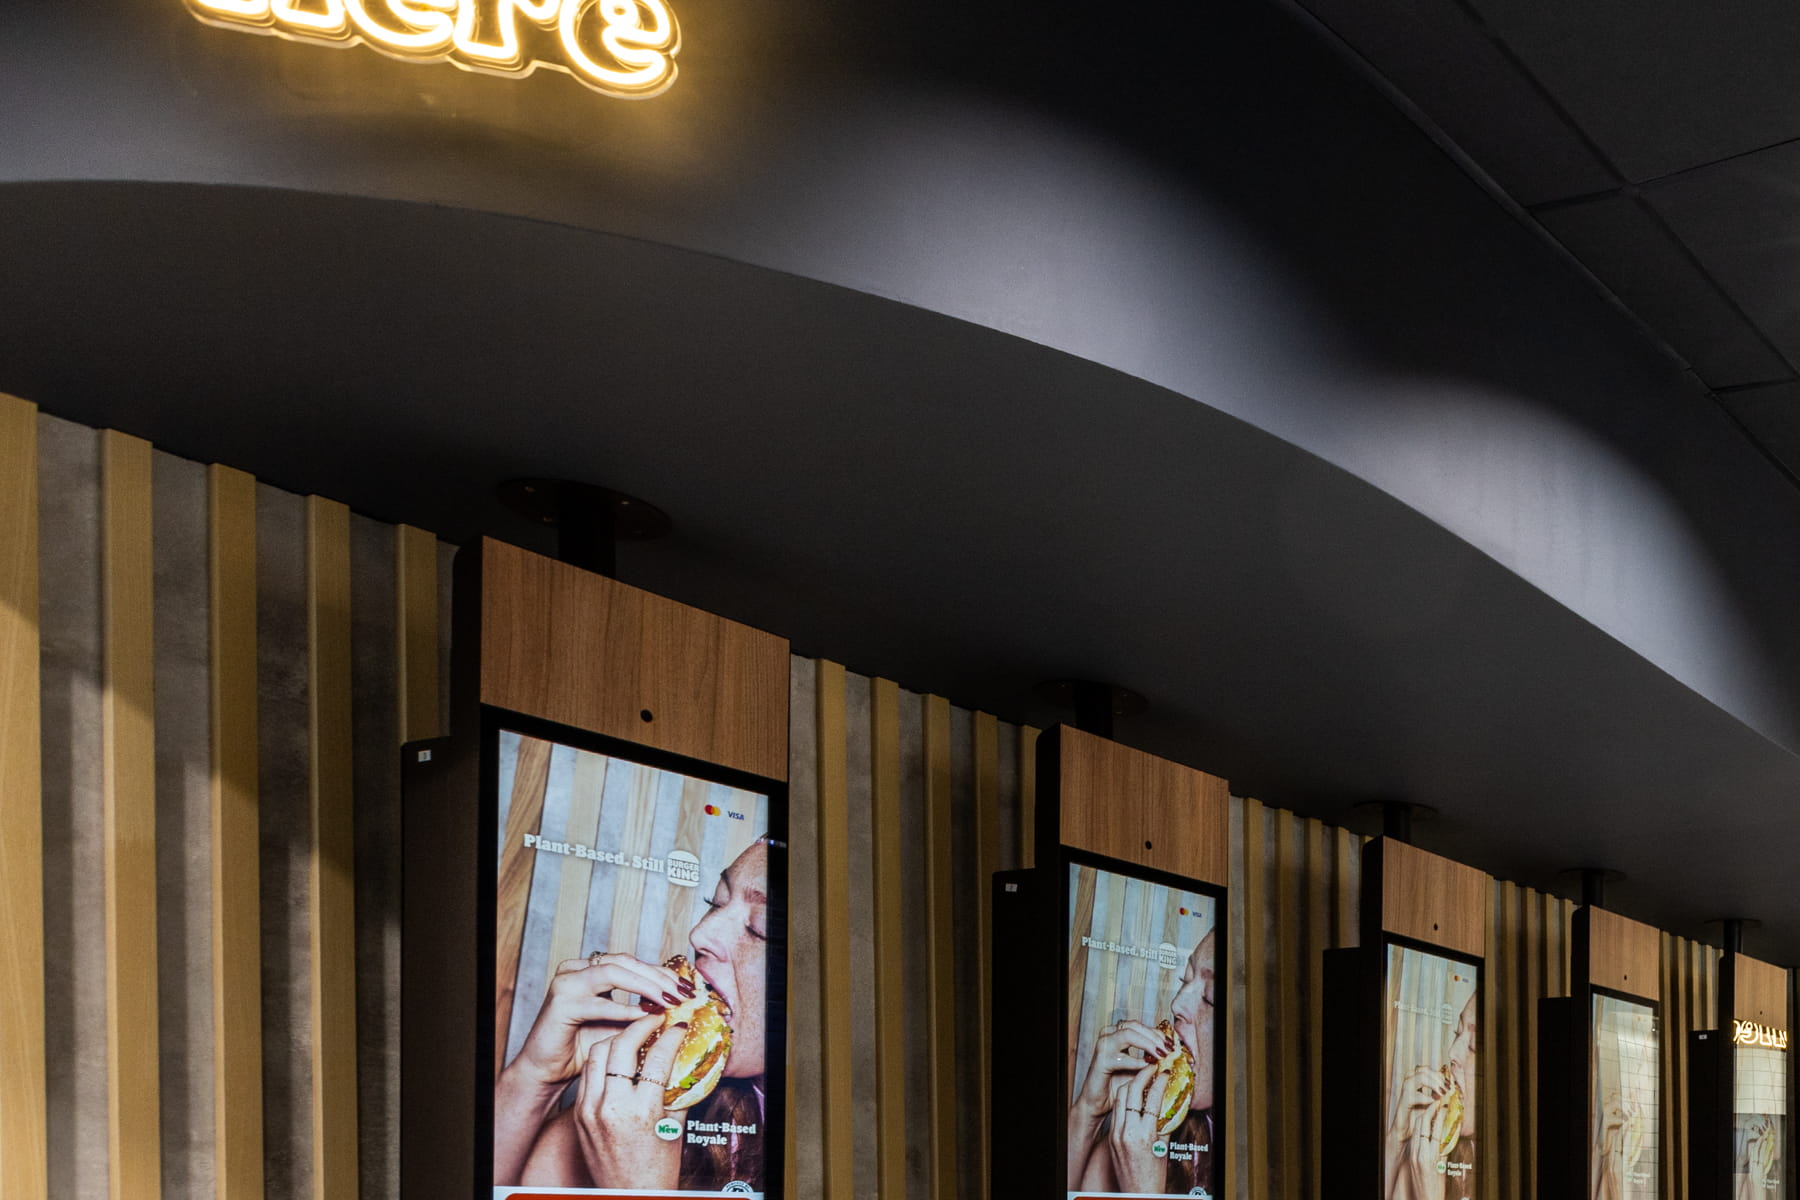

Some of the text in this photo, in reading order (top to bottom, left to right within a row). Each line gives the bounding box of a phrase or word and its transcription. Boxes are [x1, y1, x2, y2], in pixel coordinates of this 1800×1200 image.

[728, 810, 745, 821] VISA
[524, 833, 700, 882] Plant-Based. Still BURGER KING
[658, 1125, 679, 1134] New
[687, 1120, 757, 1134] Plant-Based
[687, 1133, 728, 1147] Royale
